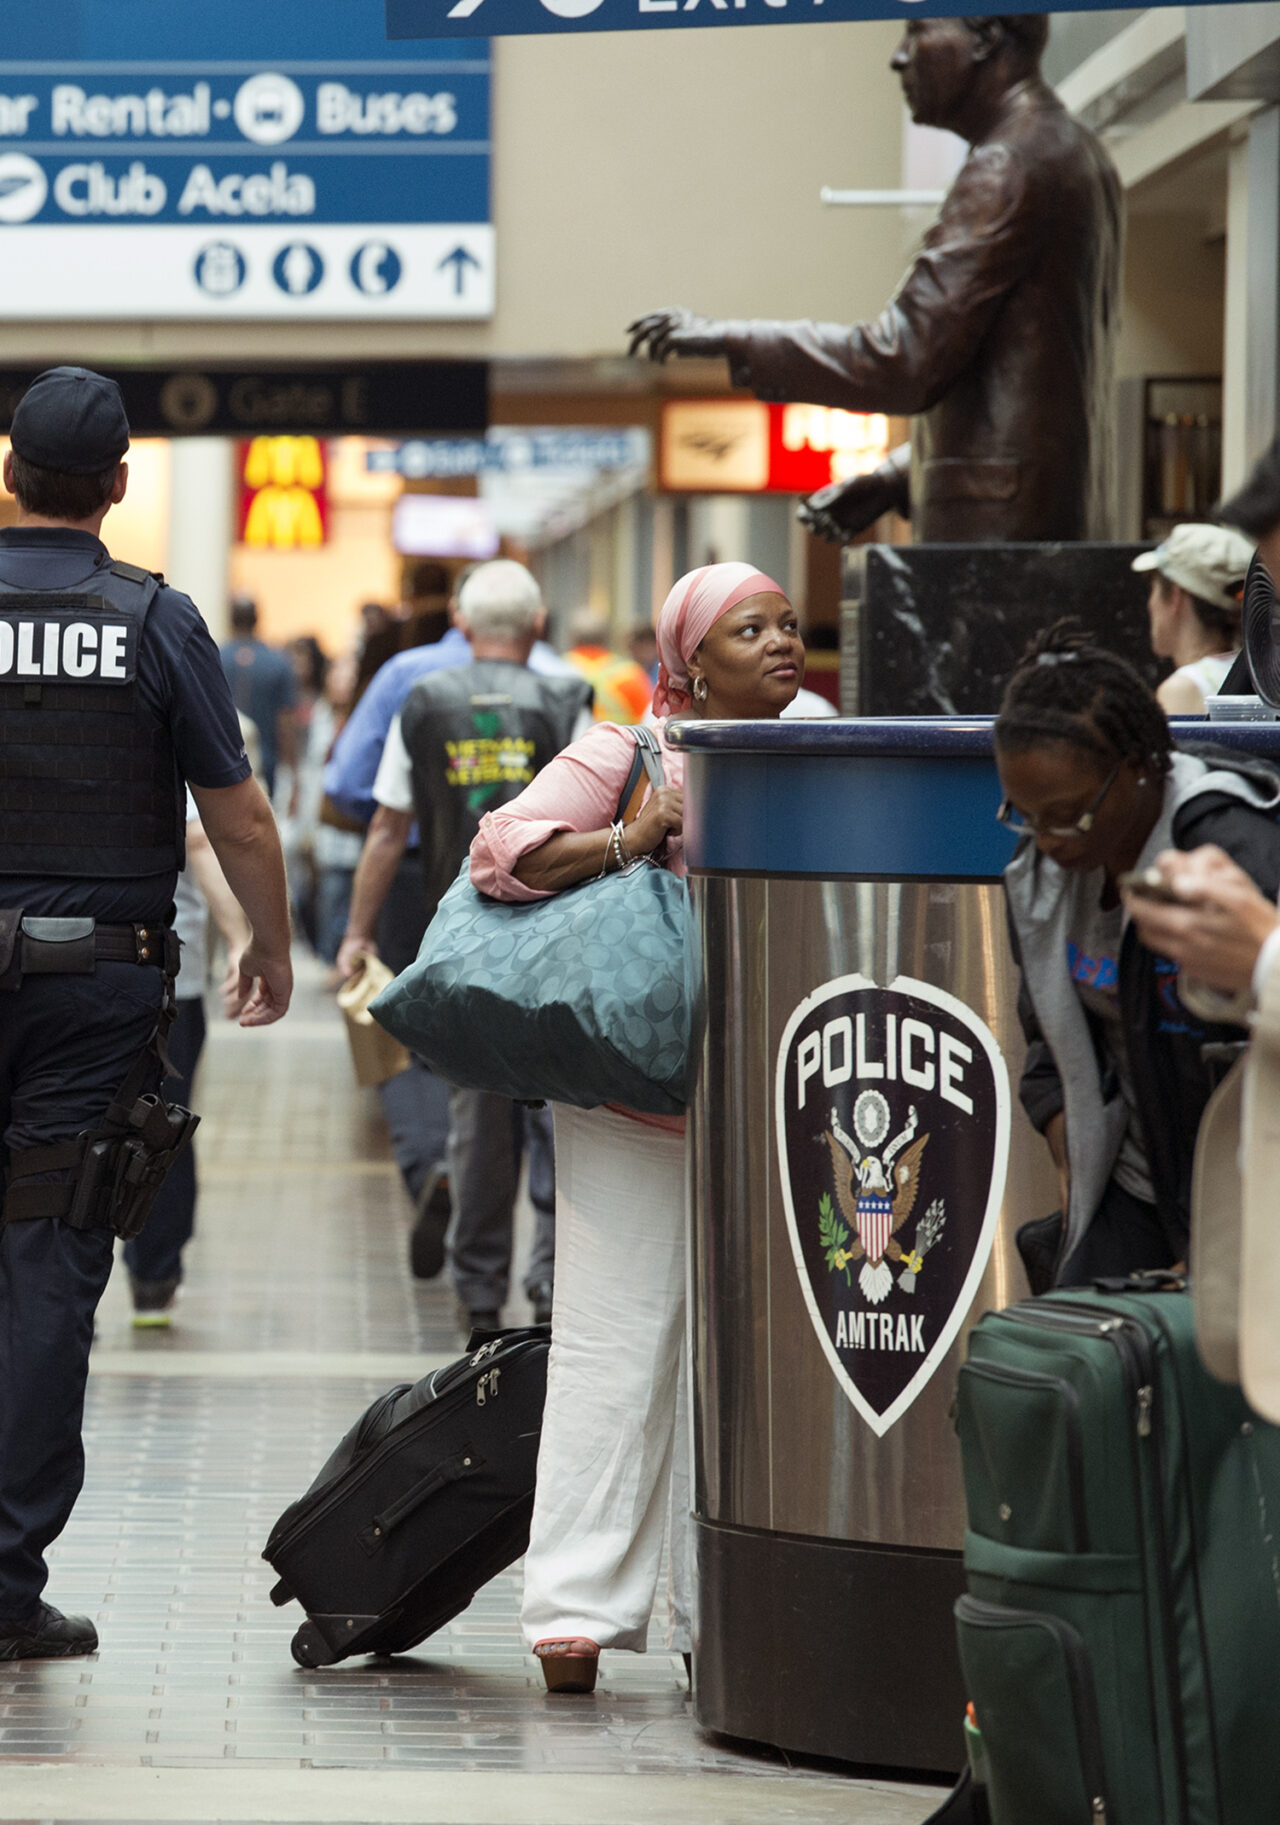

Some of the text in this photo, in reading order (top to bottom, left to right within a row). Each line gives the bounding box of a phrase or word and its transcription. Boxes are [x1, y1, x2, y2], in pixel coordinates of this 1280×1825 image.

[50, 82, 211, 137] Rental
[315, 82, 459, 135] Buses
[53, 161, 168, 216] Club
[177, 161, 316, 216] Acela
[797, 1012, 974, 1116] POLICE
[835, 1310, 926, 1353] AMTRAK
